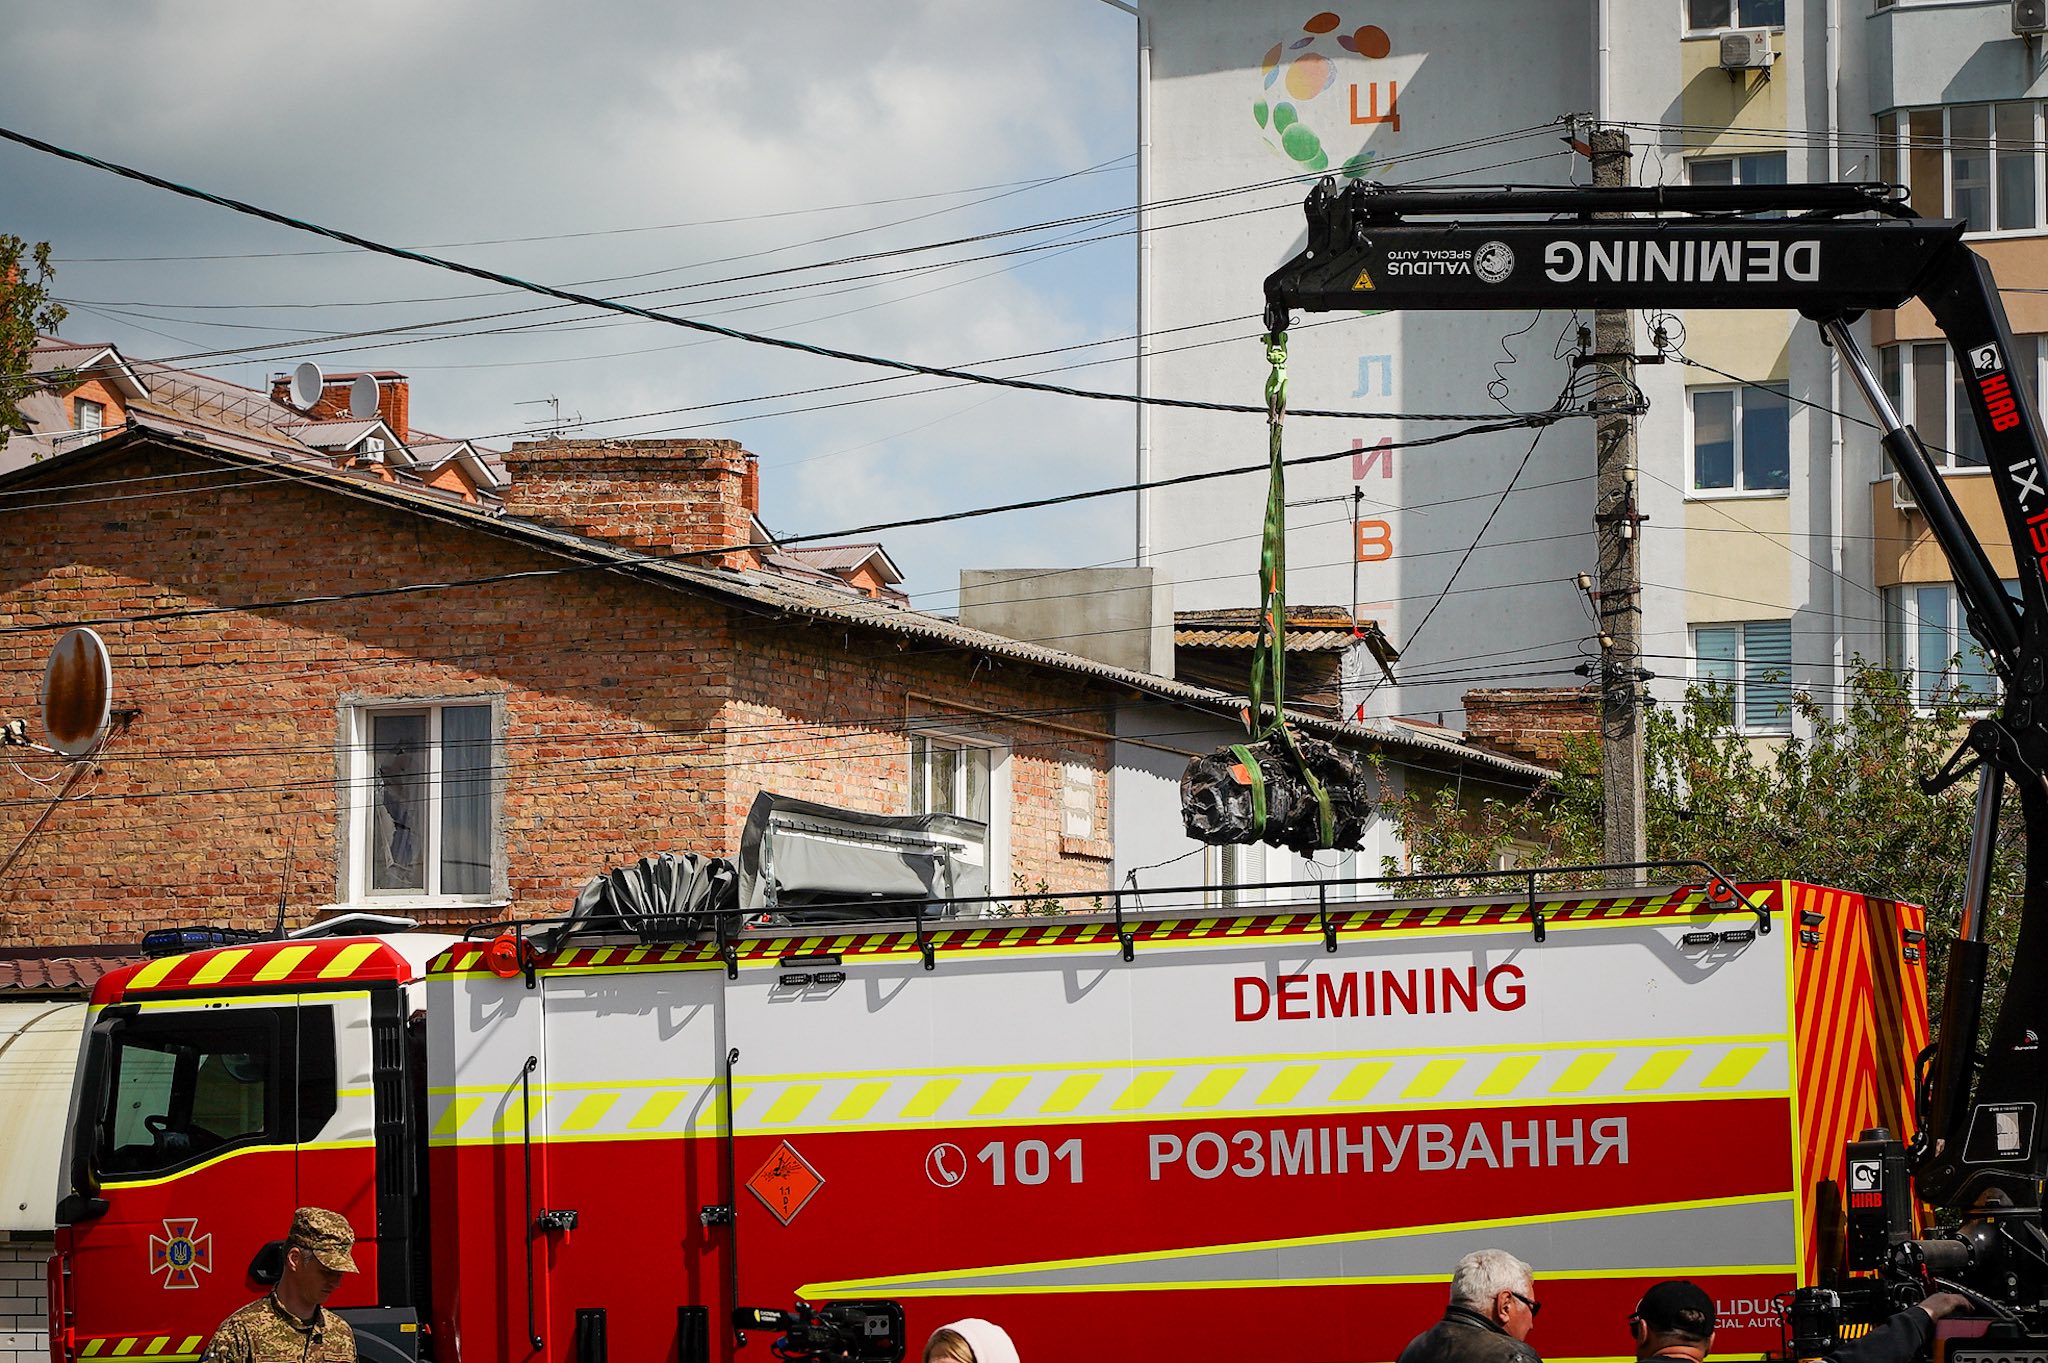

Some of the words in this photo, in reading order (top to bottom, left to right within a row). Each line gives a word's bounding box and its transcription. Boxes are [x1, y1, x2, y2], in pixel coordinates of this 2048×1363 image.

[1387, 250, 1419, 260] AUTO
[1422, 250, 1472, 259] SPECIAL
[1544, 240, 1821, 282] DEMINING
[1387, 261, 1471, 275] VALIDUS
[1979, 373, 2019, 432] HIAB
[2008, 457, 2048, 583] iX.15
[1234, 963, 1526, 1022] DEMINING
[1148, 1116, 1630, 1181] РОЗМІНУВАННЯ
[976, 1138, 1084, 1186] 101
[783, 1196, 789, 1205] D
[1851, 1192, 1882, 1208] HIAB
[783, 1205, 788, 1214] 1
[1715, 1298, 1785, 1315] LIDUS
